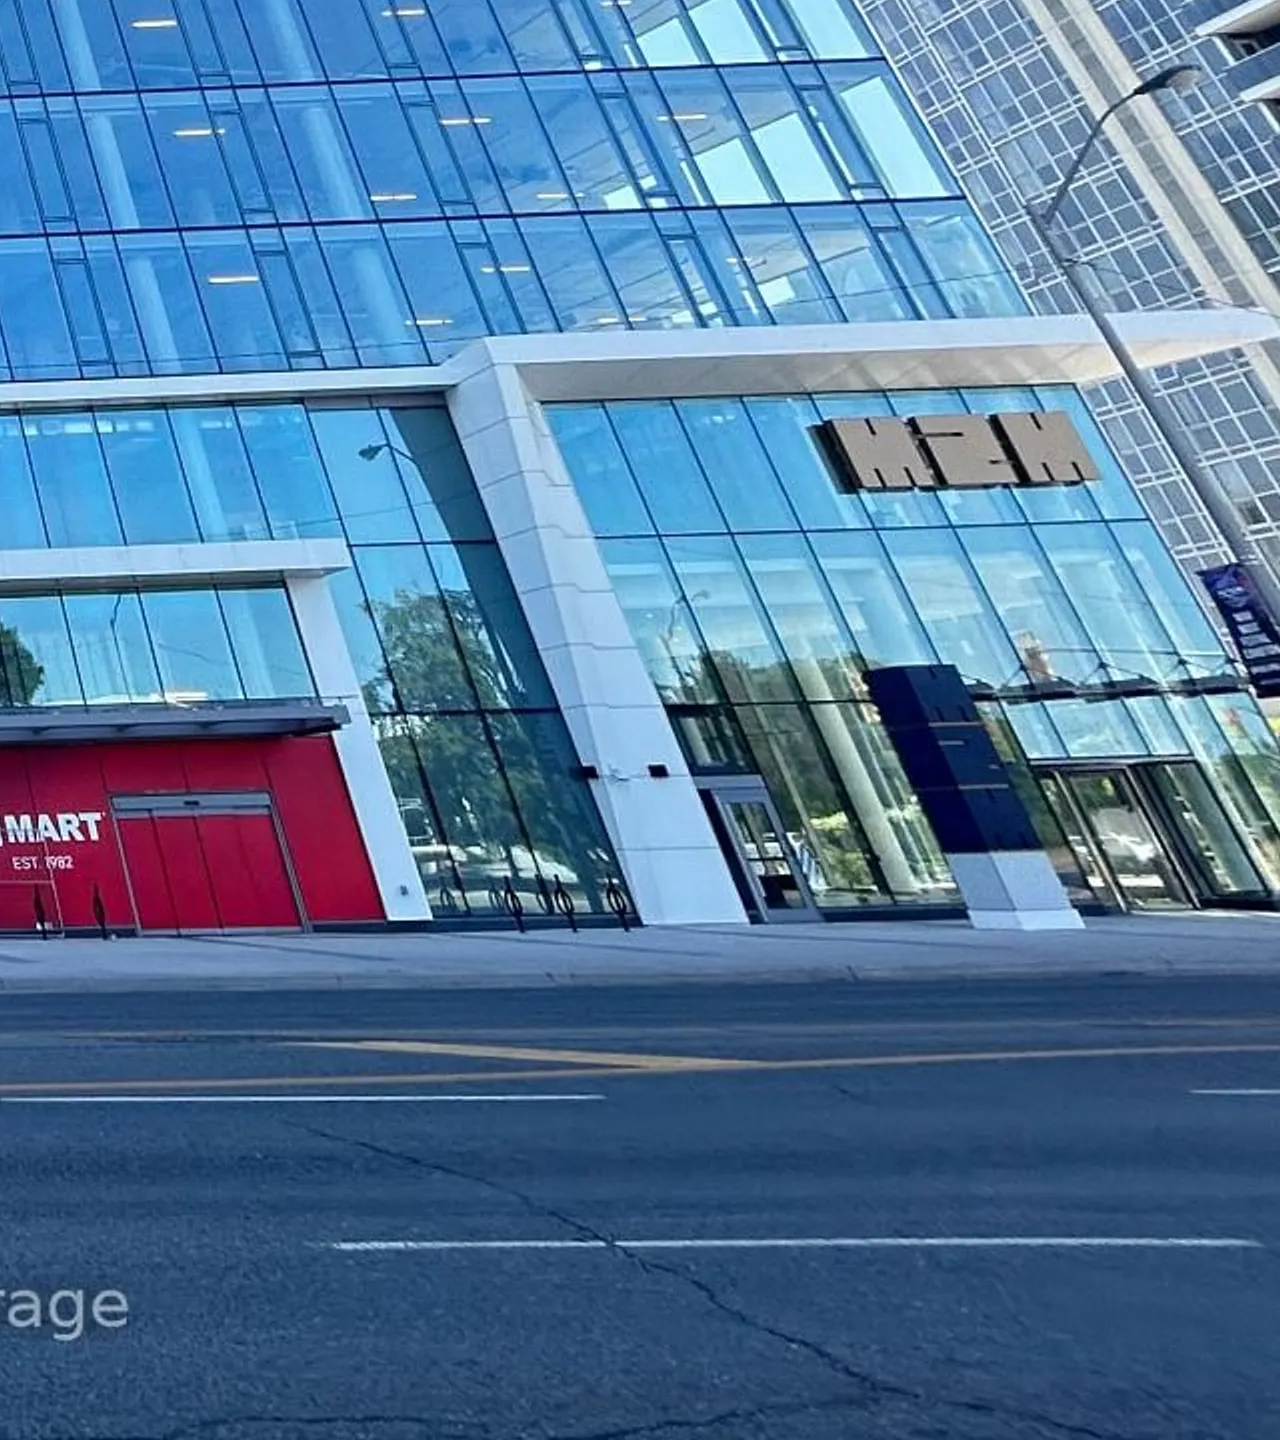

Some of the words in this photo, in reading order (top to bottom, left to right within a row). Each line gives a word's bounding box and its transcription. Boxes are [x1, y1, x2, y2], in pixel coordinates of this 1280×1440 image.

[4, 812, 102, 843] MART
[12, 856, 42, 870] EST.
[44, 855, 74, 870] 1982
